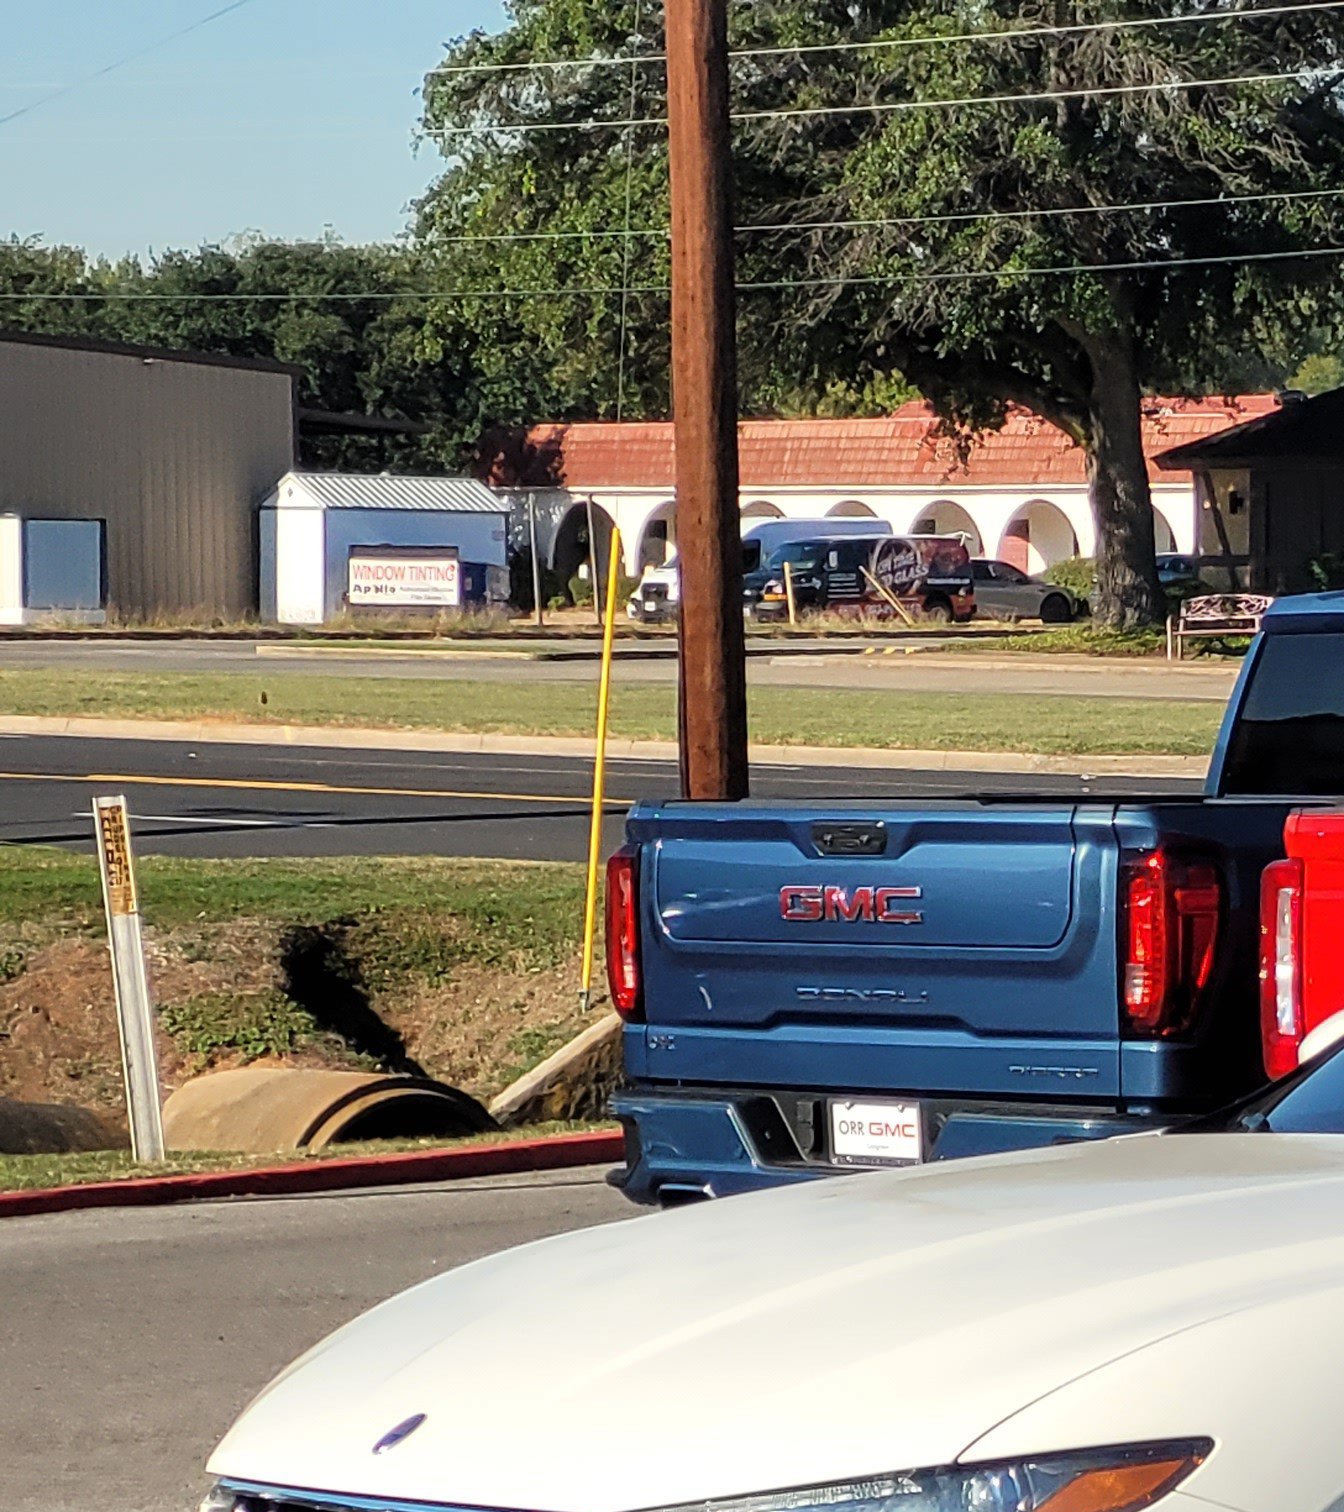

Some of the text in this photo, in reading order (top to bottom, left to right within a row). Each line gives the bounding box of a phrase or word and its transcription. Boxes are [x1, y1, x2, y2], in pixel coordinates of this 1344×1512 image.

[353, 565, 455, 581] WINDOW TINTING
[779, 884, 923, 923] GMC
[839, 1120, 916, 1138] ORR GMC
